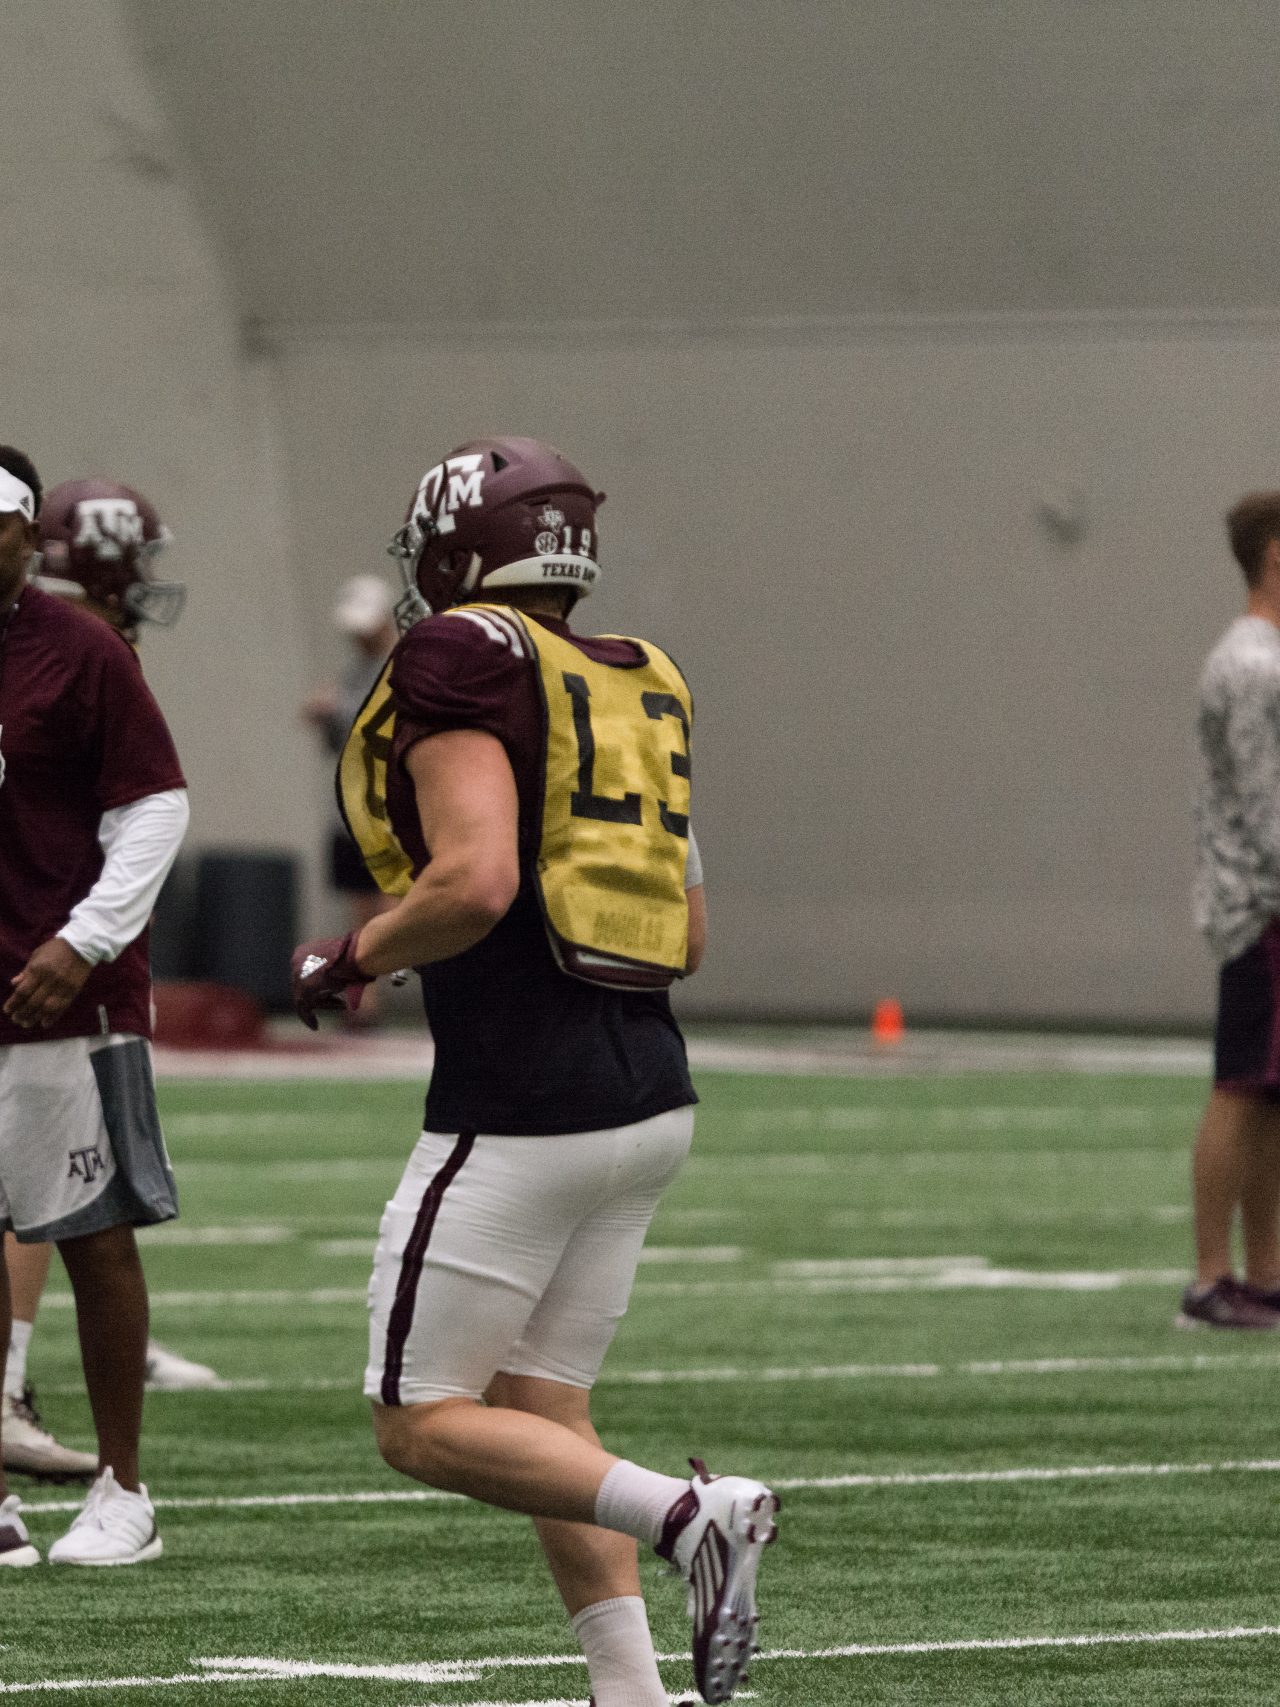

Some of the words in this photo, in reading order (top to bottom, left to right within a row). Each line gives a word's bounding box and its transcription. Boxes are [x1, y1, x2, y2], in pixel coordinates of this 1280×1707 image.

[562, 525, 592, 557] 19
[541, 562, 581, 579] TEXAS
[561, 671, 691, 838] 13
